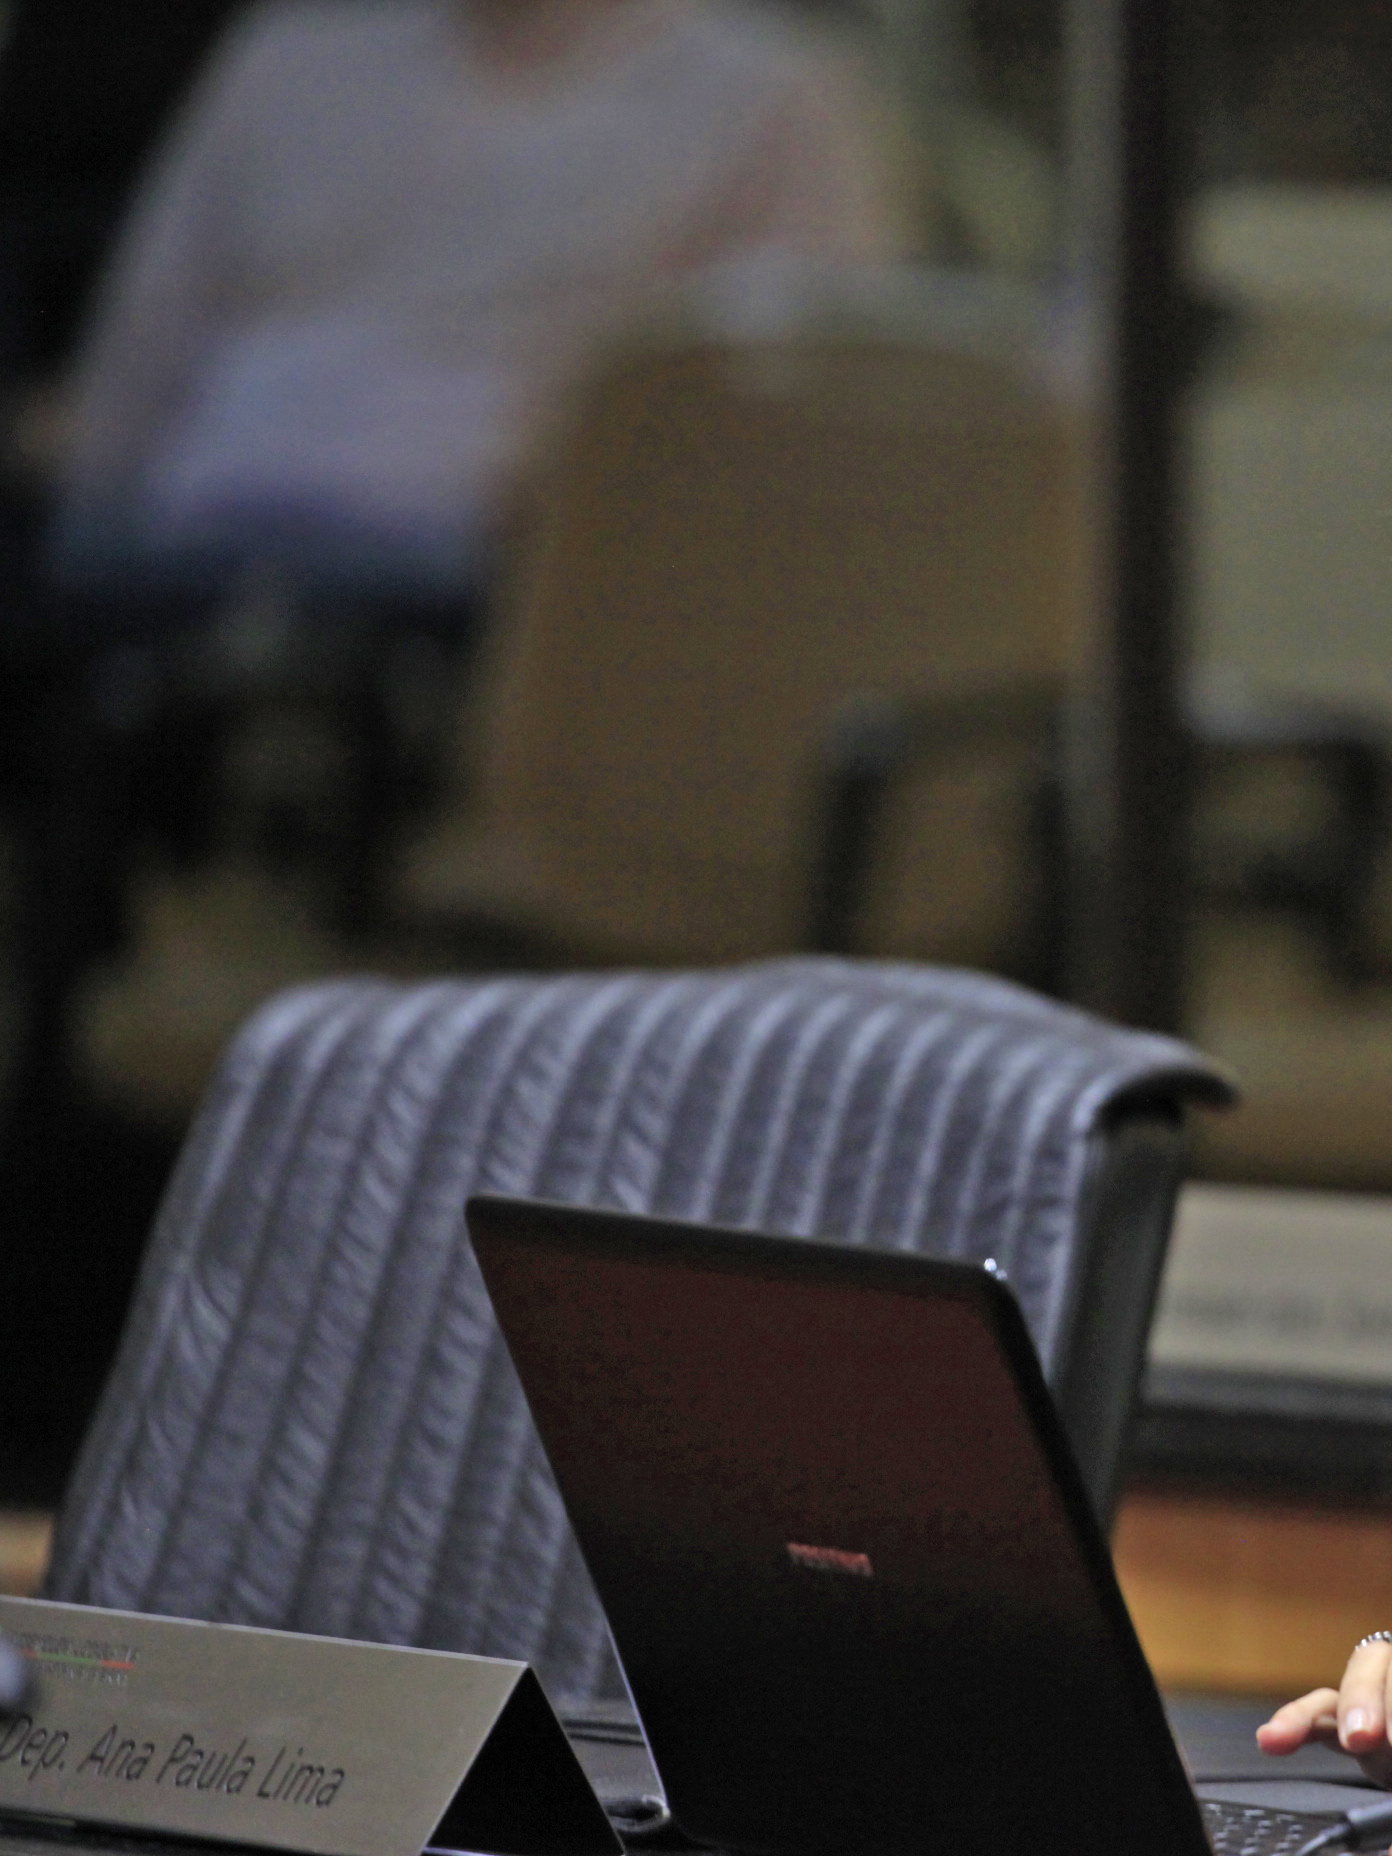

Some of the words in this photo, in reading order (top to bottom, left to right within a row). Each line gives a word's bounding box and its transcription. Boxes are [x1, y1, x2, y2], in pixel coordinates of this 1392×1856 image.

[0, 1712, 69, 1782] Dep.
[77, 1724, 155, 1781] Ana
[156, 1733, 255, 1794] Paula
[257, 1746, 345, 1807] Lima
